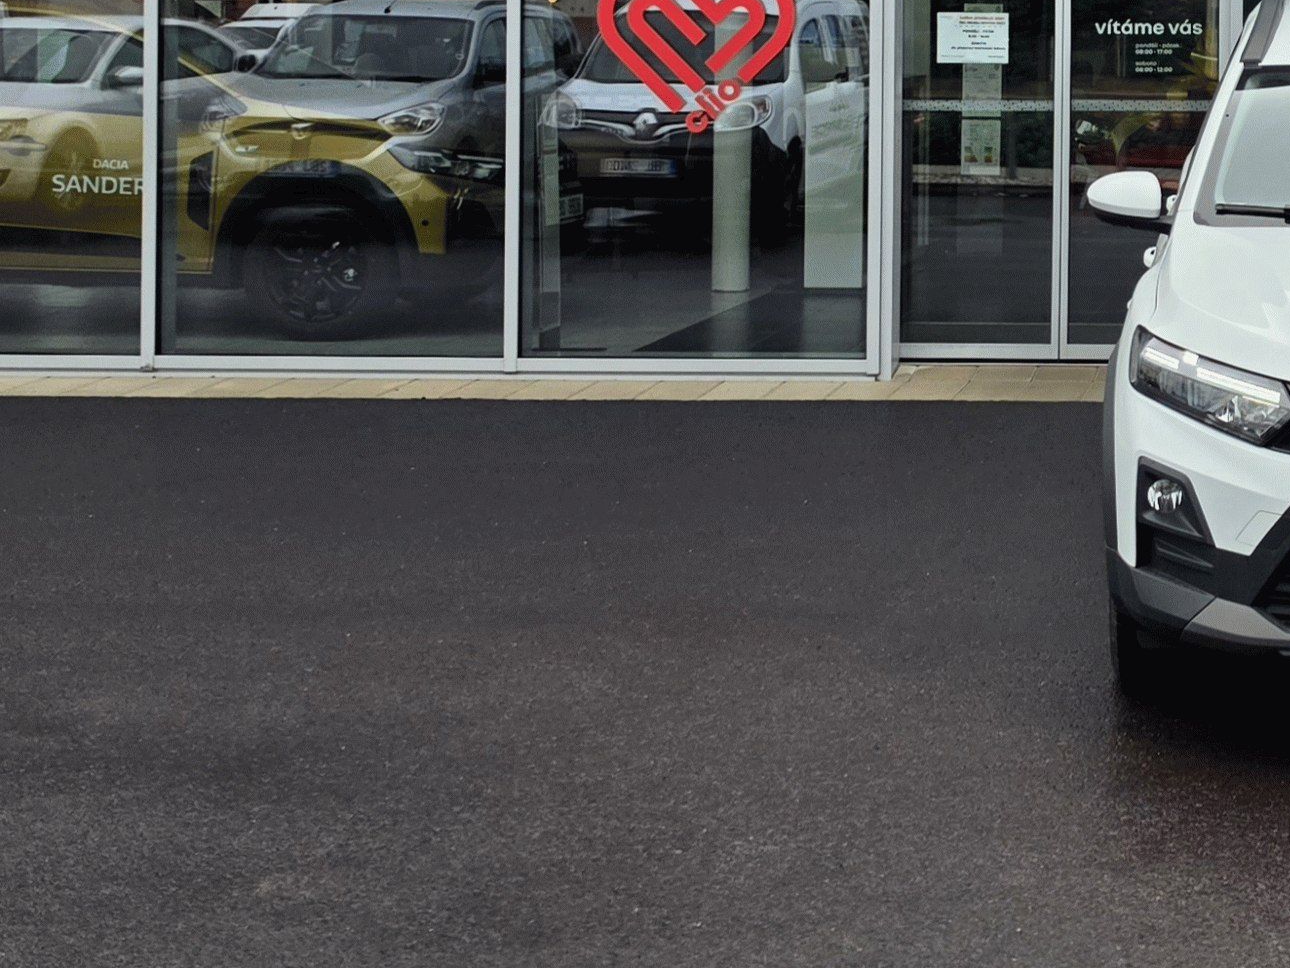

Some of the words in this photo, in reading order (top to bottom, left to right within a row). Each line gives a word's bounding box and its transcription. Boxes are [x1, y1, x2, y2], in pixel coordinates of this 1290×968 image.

[1094, 18, 1165, 35] vítáme
[1168, 18, 1203, 35] vás
[686, 82, 742, 133] clio
[93, 159, 129, 170] DACIA
